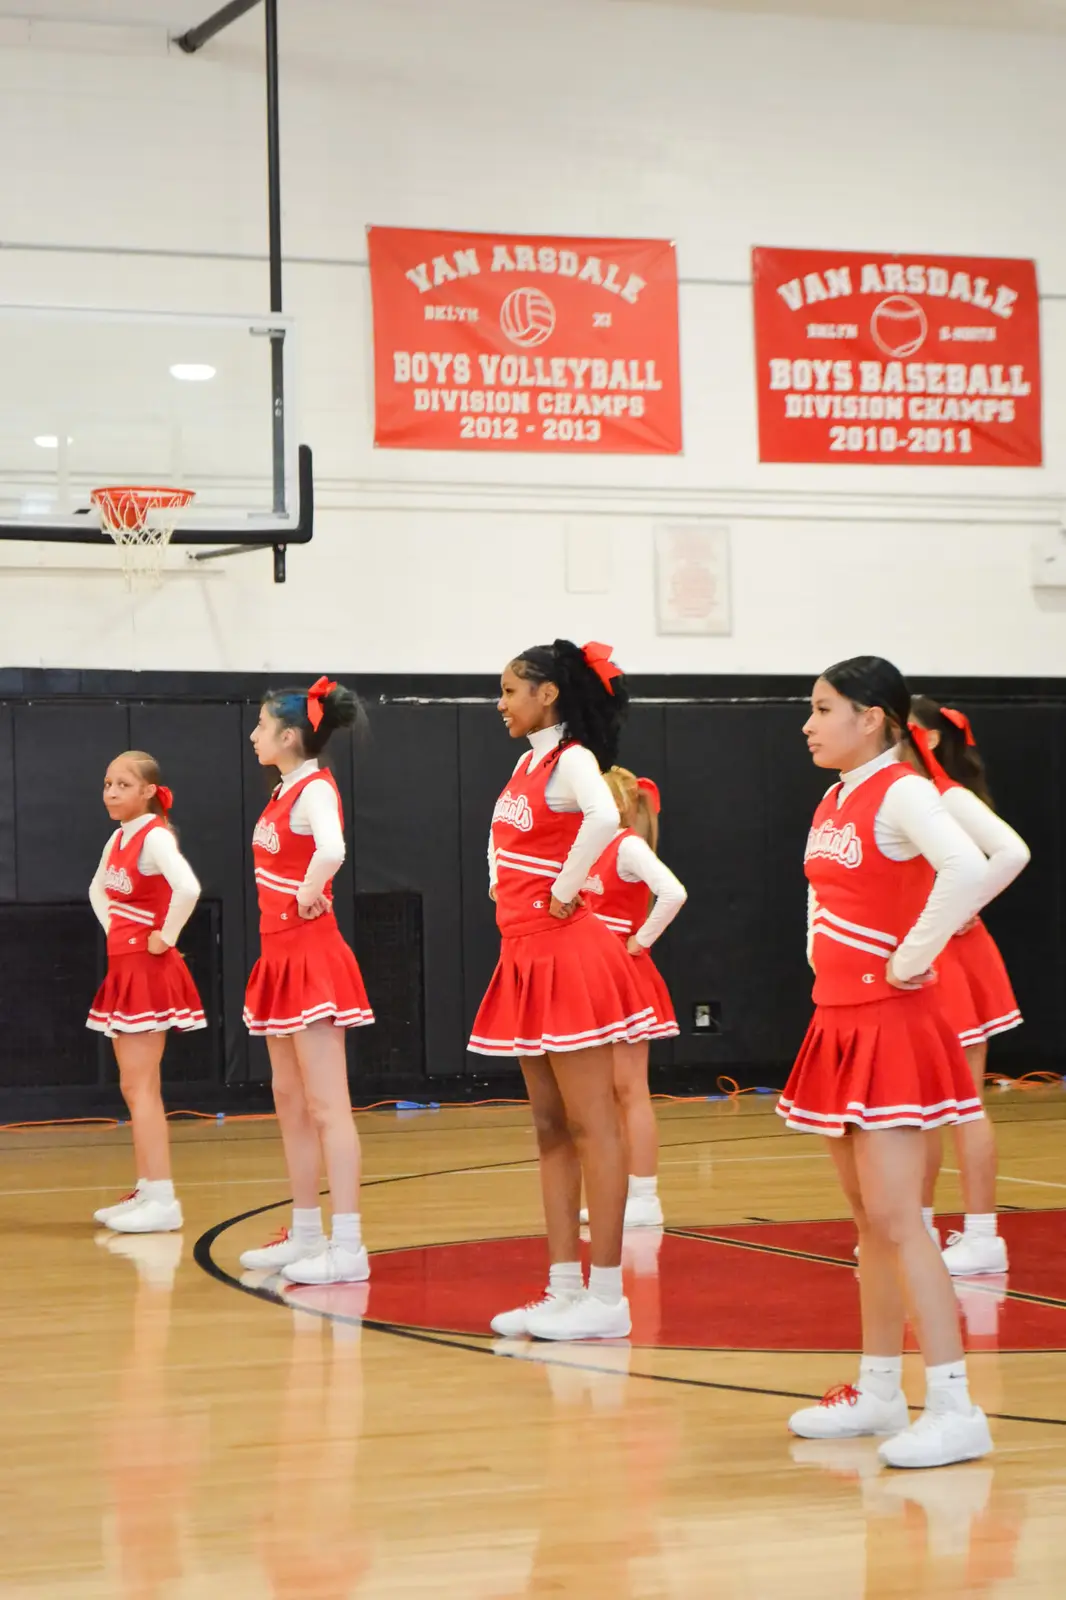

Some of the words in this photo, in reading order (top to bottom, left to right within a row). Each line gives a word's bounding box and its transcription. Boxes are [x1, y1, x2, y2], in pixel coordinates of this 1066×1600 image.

[406, 249, 480, 293] VAN
[491, 246, 646, 304] ARSDALE
[777, 267, 852, 311] VAN
[860, 264, 1017, 319] ARSDALE
[394, 352, 470, 384] BOYS
[478, 354, 662, 391] VOLLEYBALL
[769, 358, 853, 391] BOYS
[859, 360, 1030, 396] BASEBALL
[414, 389, 530, 413] DIVISION
[538, 391, 644, 417] CHAMPS
[785, 394, 904, 419] DIVISION
[908, 397, 1015, 422] CHAMPS
[460, 416, 518, 439] 2012
[542, 419, 600, 441] 2013
[829, 426, 972, 453] 2010-2011
